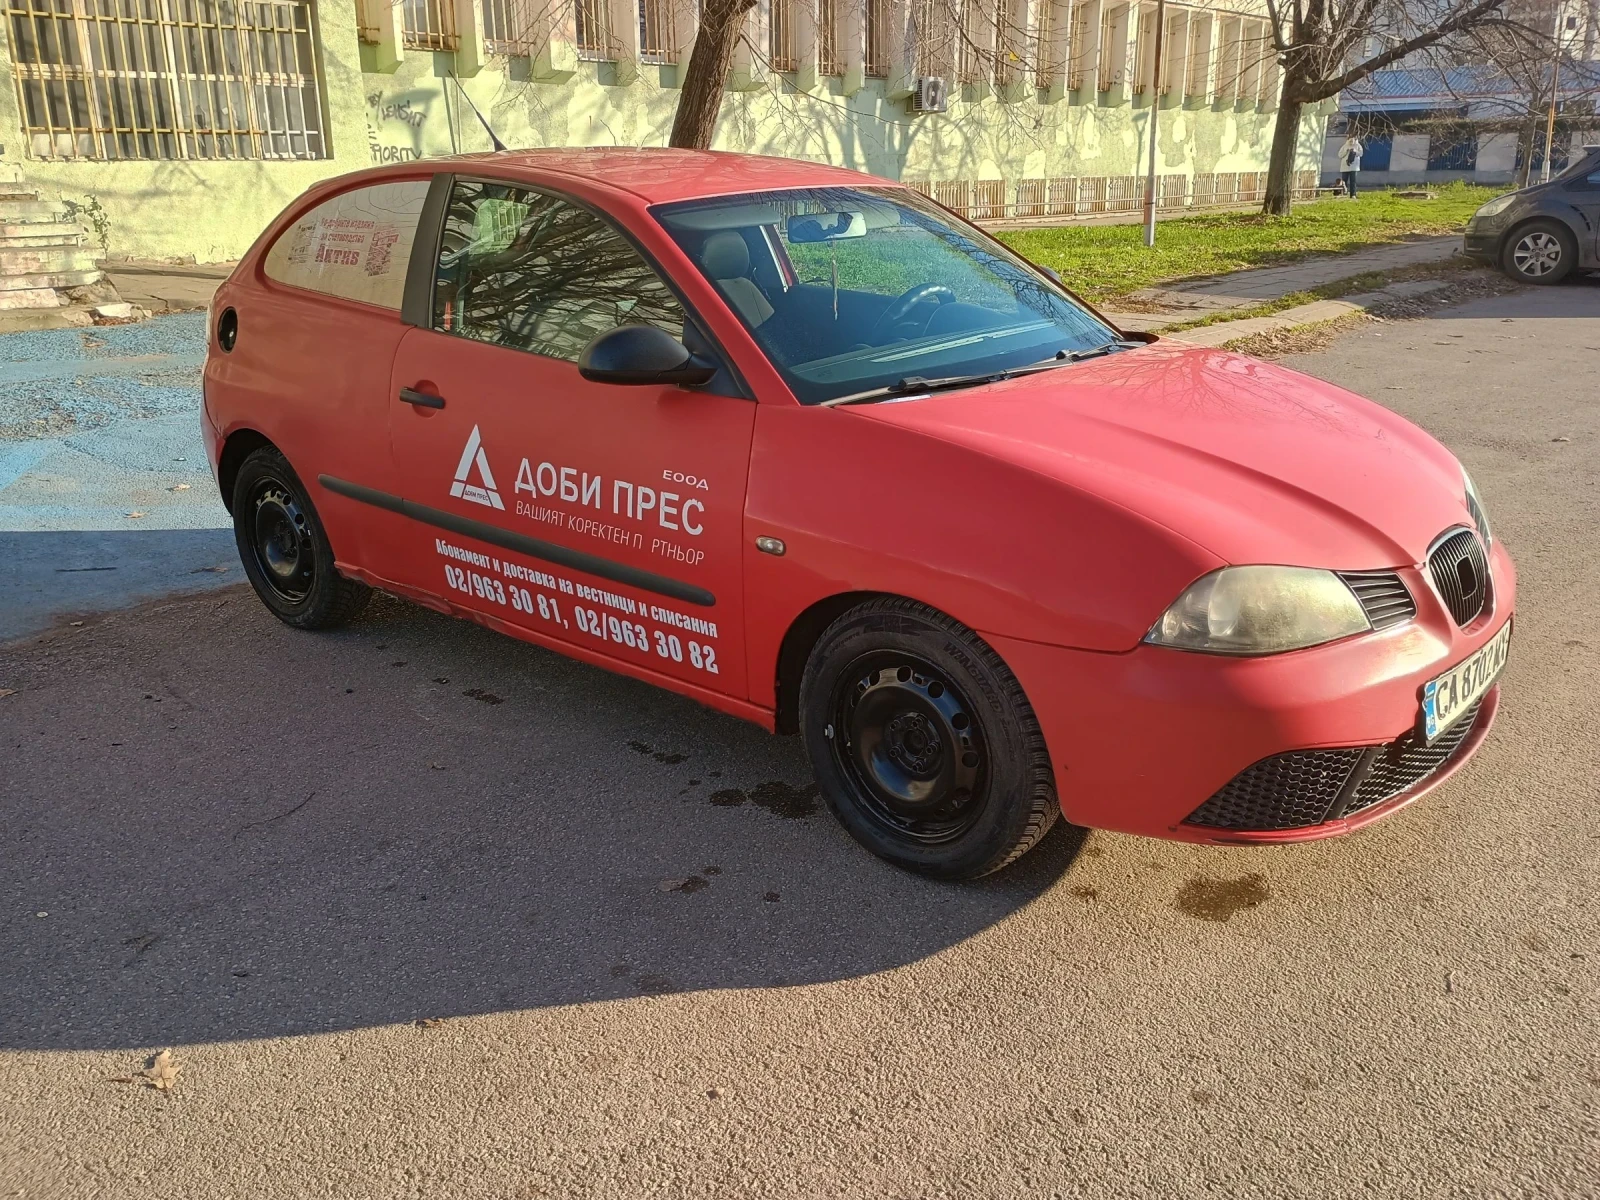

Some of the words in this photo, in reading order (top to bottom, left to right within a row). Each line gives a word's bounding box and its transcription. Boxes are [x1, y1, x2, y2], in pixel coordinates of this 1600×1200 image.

[514, 458, 601, 509] ДОБИ
[613, 480, 705, 536] ПРЕС
[662, 469, 709, 491] ЕООД
[515, 500, 566, 527] ВАШИЯТ
[567, 515, 629, 546] КОРЕКТЕН
[435, 538, 491, 570] Абонамент
[492, 558, 501, 573] и
[503, 561, 556, 590] доставка
[557, 578, 574, 595] на
[576, 583, 637, 615] вестници
[638, 601, 649, 618] и
[650, 605, 718, 639] списания
[444, 564, 507, 605] 02/963
[509, 585, 534, 614] 30
[536, 593, 569, 630] 81,
[574, 605, 650, 652] 02/963
[653, 630, 683, 663] 30
[688, 640, 719, 674] 82
